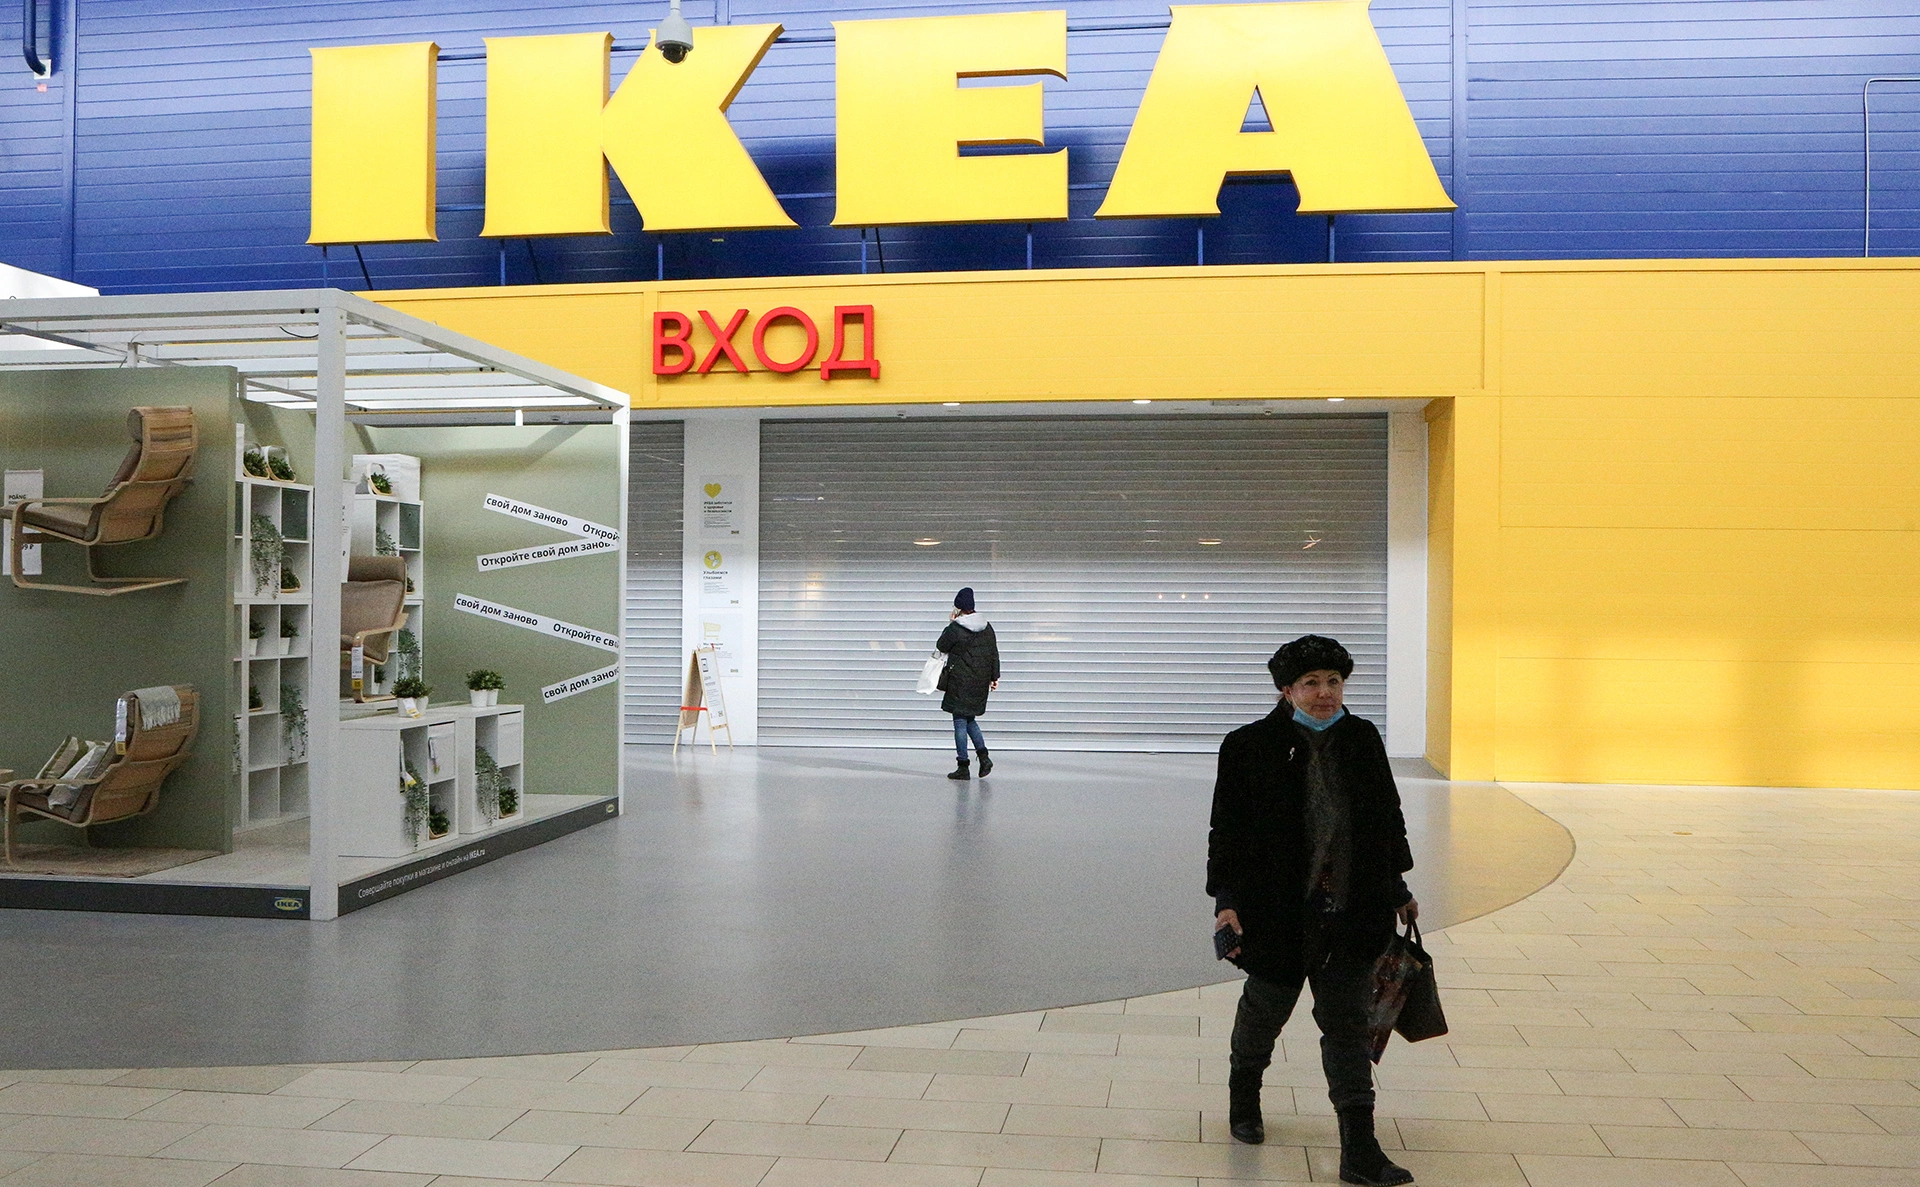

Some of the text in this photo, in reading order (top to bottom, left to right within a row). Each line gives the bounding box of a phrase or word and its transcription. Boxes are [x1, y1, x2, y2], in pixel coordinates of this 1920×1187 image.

[306, 0, 1458, 246] IKEA
[653, 304, 880, 381] ВХОД
[486, 497, 510, 510] свой
[511, 504, 532, 516] дом
[533, 510, 569, 527] заново
[481, 552, 530, 567] Откройте
[531, 547, 556, 560] свой
[557, 544, 579, 557] дом
[456, 597, 480, 610] свой
[480, 604, 502, 617] дом
[503, 611, 539, 627] заново
[553, 623, 602, 644] Откройте
[544, 684, 568, 699] свой
[569, 678, 590, 691] дом
[358, 880, 393, 899] Совершайте
[392, 873, 415, 887] покупки
[418, 864, 442, 877] магазине
